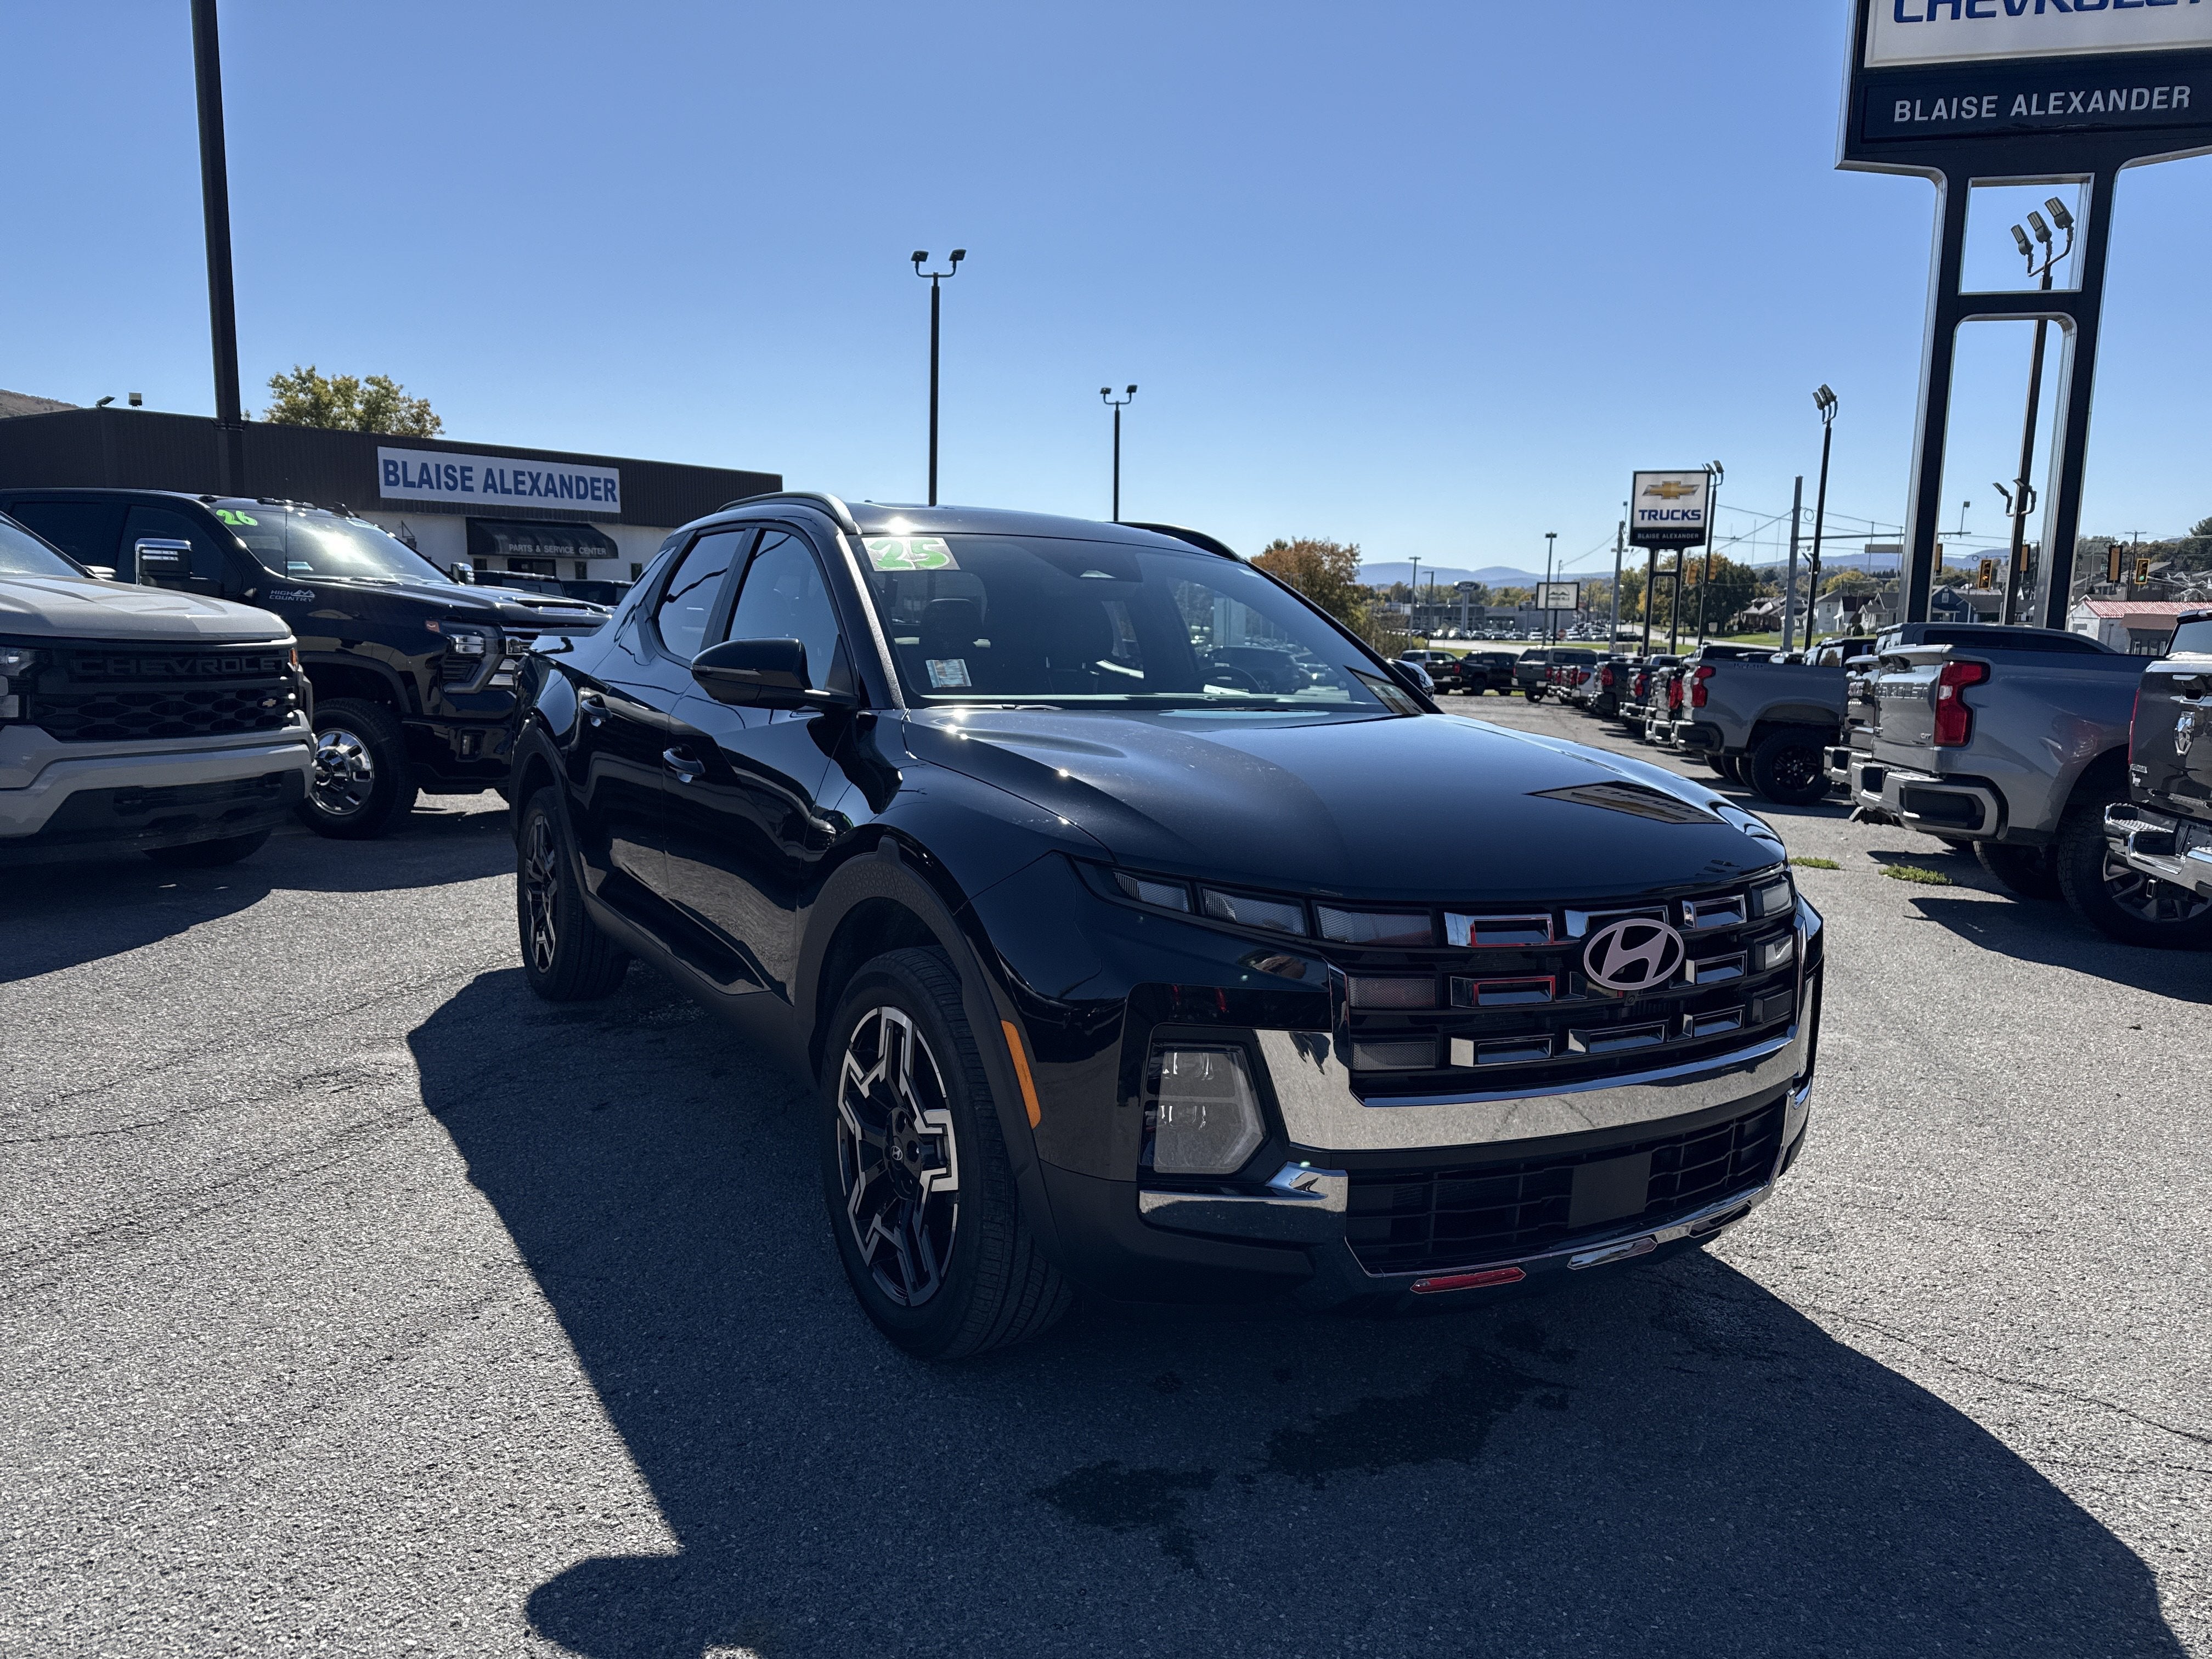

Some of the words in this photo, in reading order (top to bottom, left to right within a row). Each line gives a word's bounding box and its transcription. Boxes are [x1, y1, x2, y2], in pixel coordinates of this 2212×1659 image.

[1894, 95, 1998, 123] BLAISE
[2010, 86, 2191, 117] ALEXANDER
[382, 459, 474, 492] BLAISE
[482, 467, 618, 502] ALEXANDER
[216, 509, 257, 526] 26
[1638, 509, 1701, 521] TRUCKS
[509, 544, 533, 552] PARTS
[544, 545, 575, 554] SERVICE
[579, 546, 606, 555] CENTER
[868, 539, 950, 569] 25
